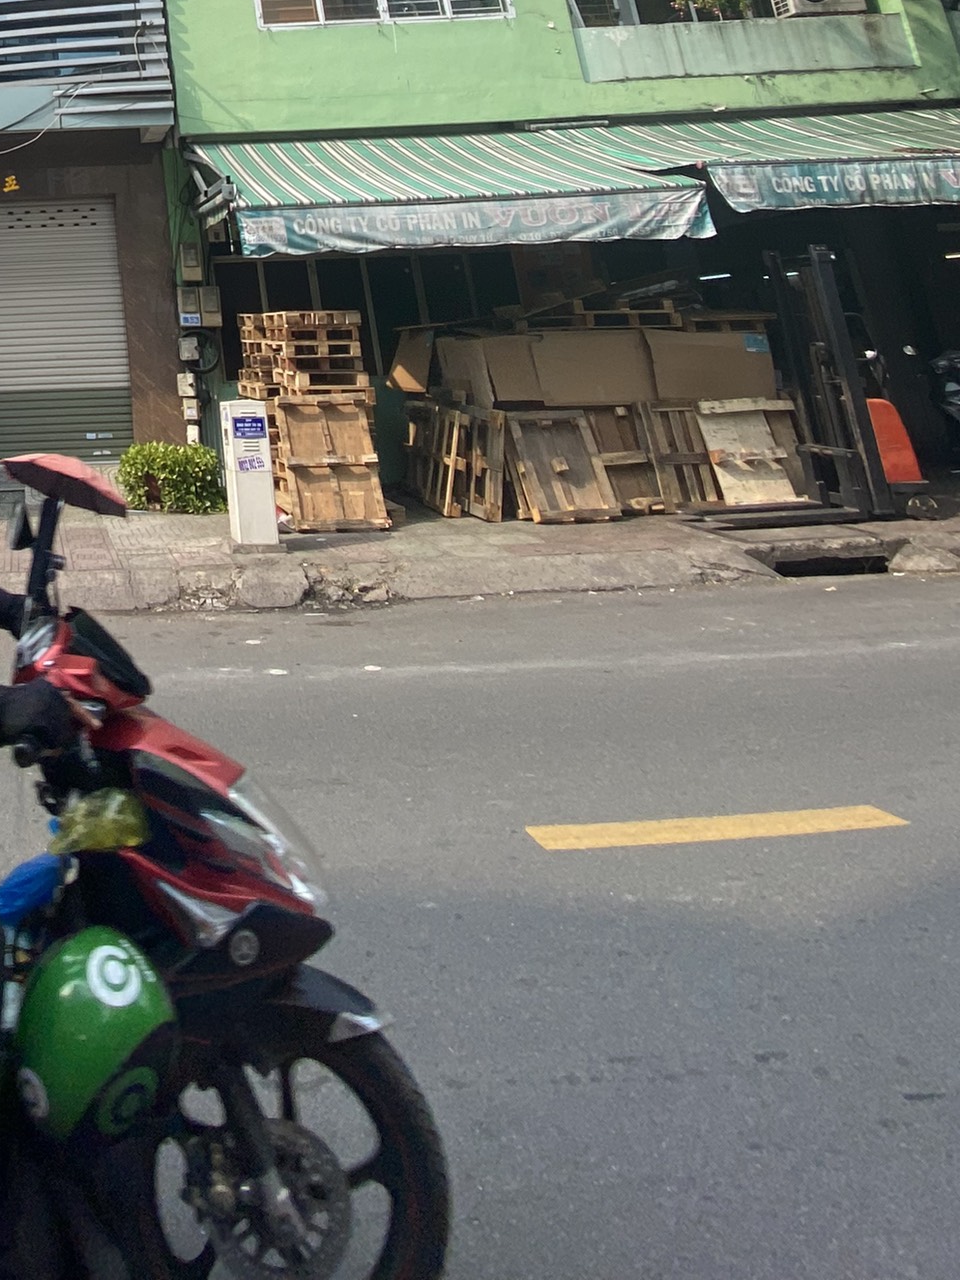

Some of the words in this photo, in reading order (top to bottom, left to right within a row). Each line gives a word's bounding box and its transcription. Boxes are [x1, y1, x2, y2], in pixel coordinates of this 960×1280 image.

[772, 173, 815, 193] CÔNG
[817, 174, 839, 192] TY
[293, 213, 342, 235] CÔNG
[350, 216, 369, 233] TY
[462, 211, 481, 229] IN
